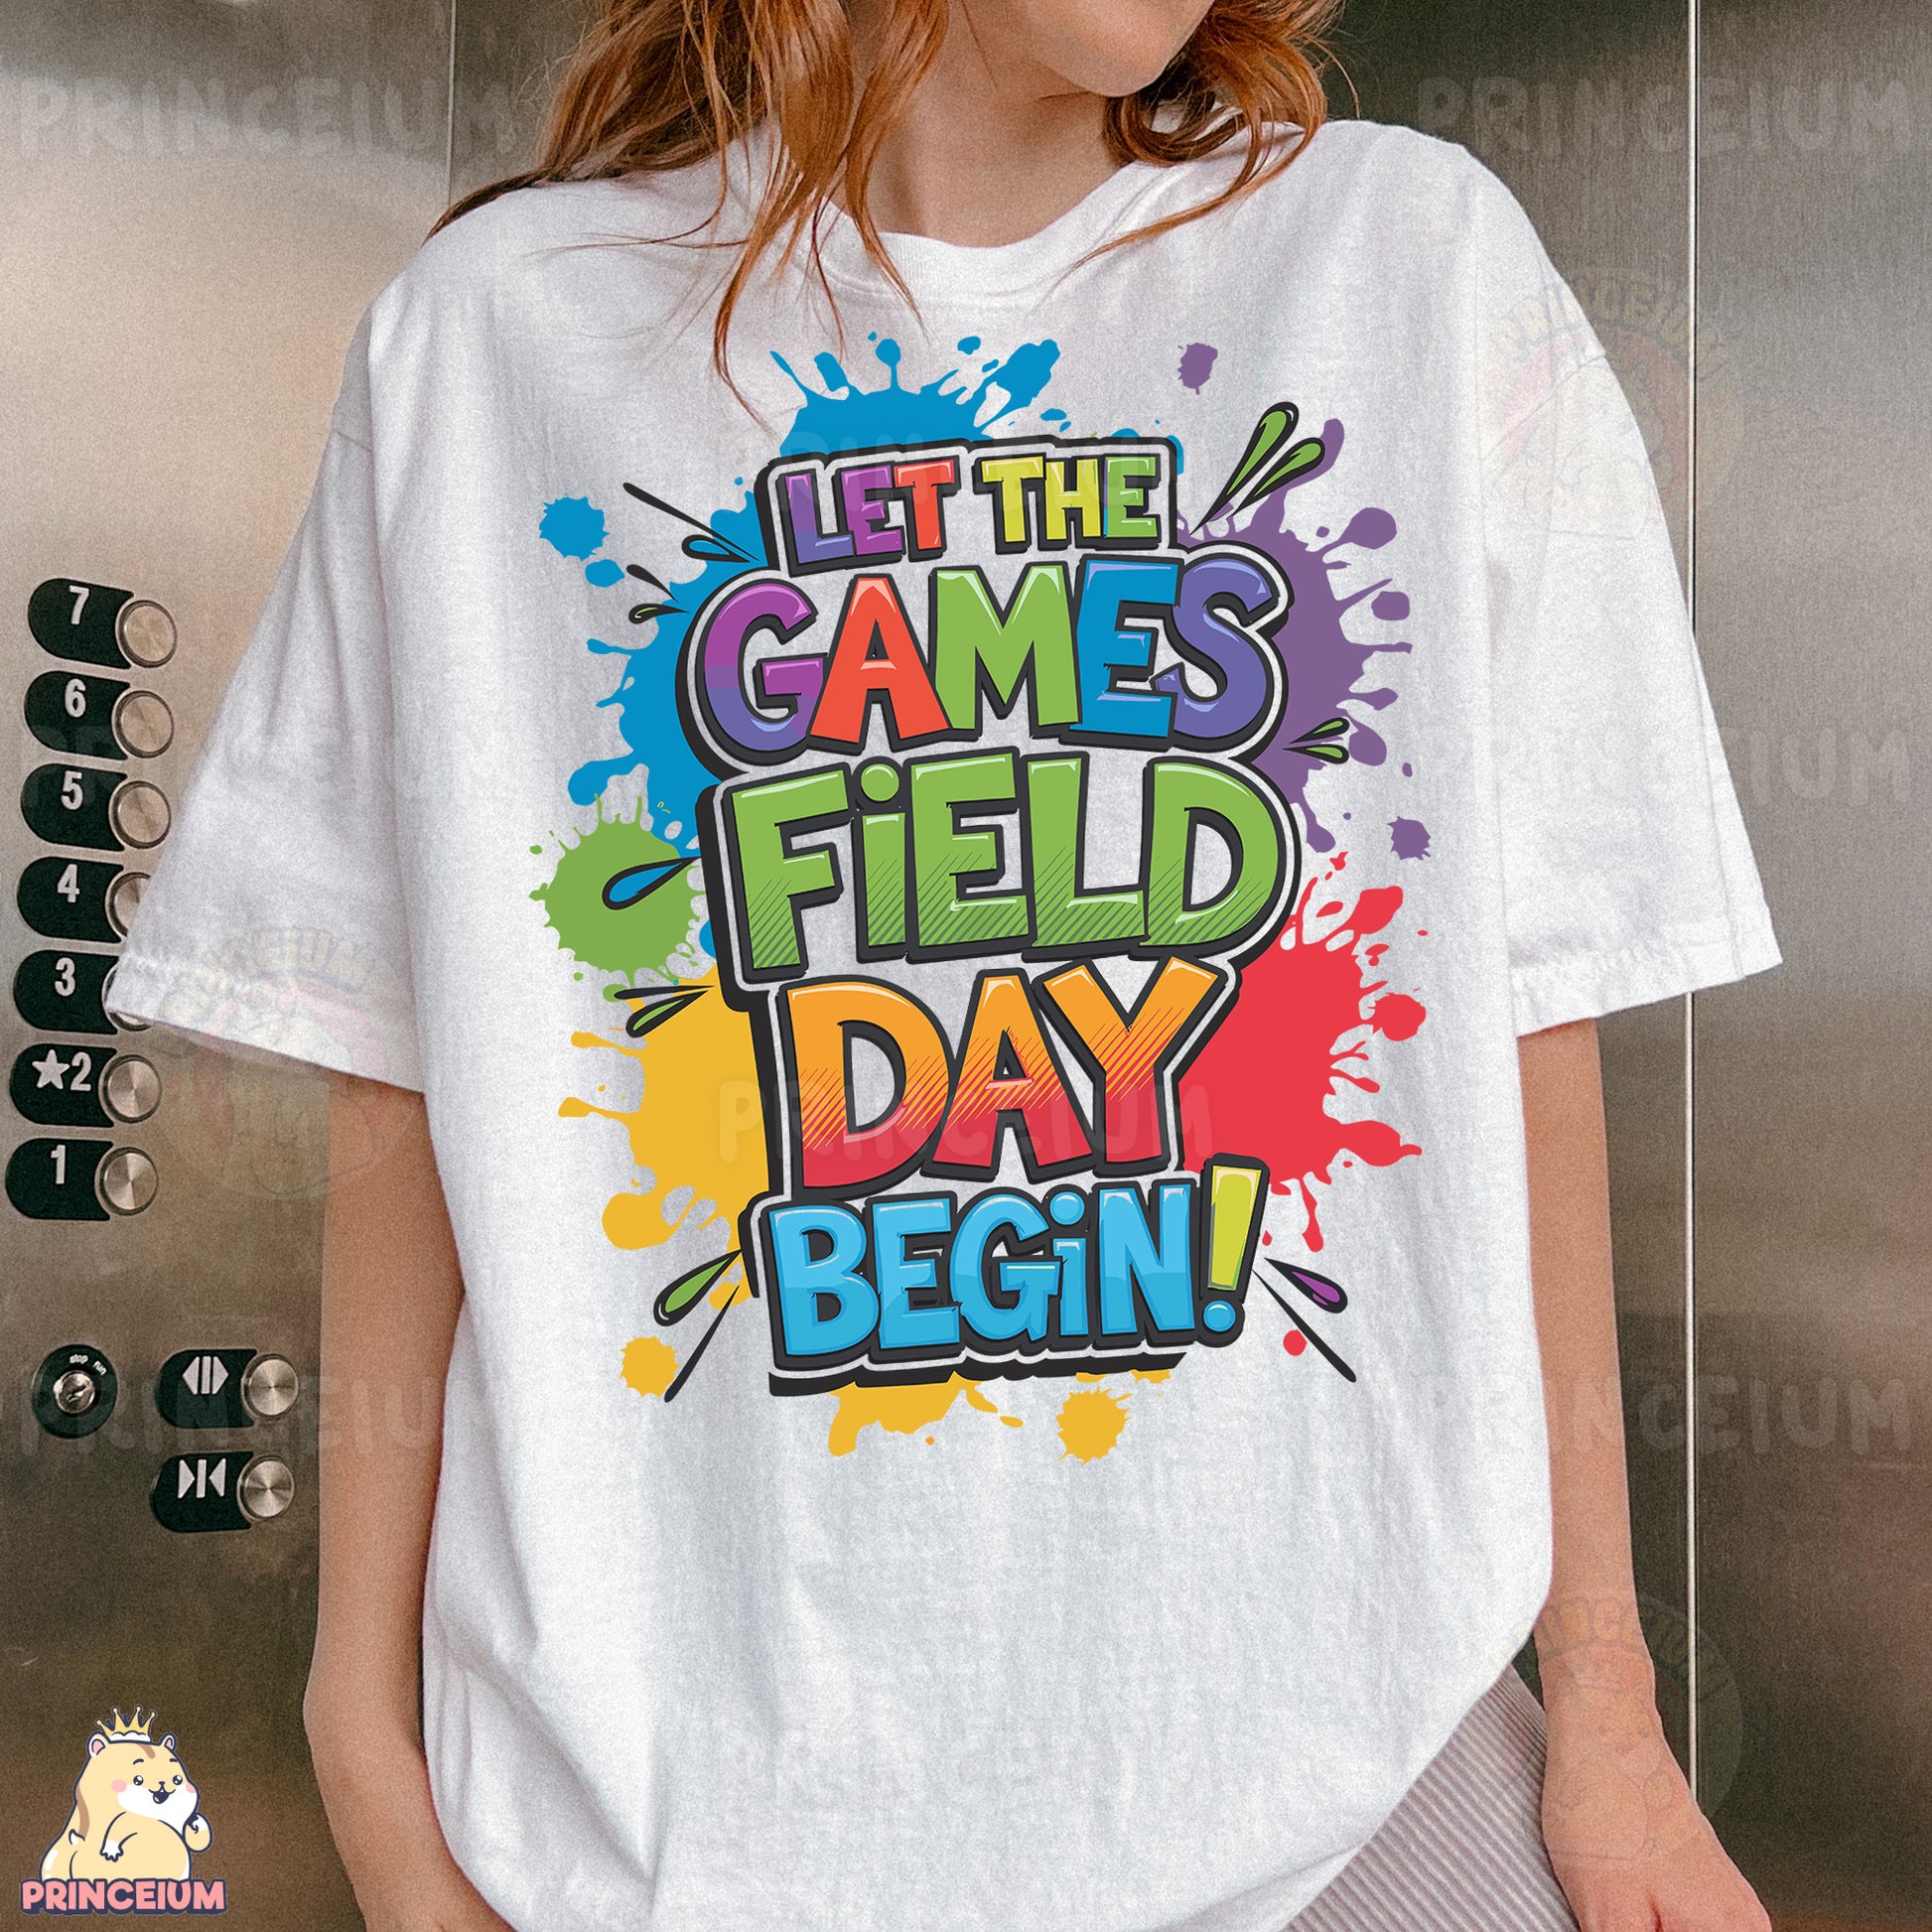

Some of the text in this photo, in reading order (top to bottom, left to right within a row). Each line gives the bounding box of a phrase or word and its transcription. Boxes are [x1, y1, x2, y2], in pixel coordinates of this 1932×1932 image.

[781, 457, 959, 568] LET
[977, 452, 1161, 548] THE
[69, 585, 90, 625] 7
[700, 554, 1278, 755] GAMES
[65, 678, 86, 718] 6
[61, 770, 83, 810] 5
[57, 864, 80, 903] 4
[54, 957, 76, 997] 3
[785, 954, 1223, 1191] DAY
[50, 1144, 67, 1185] 1
